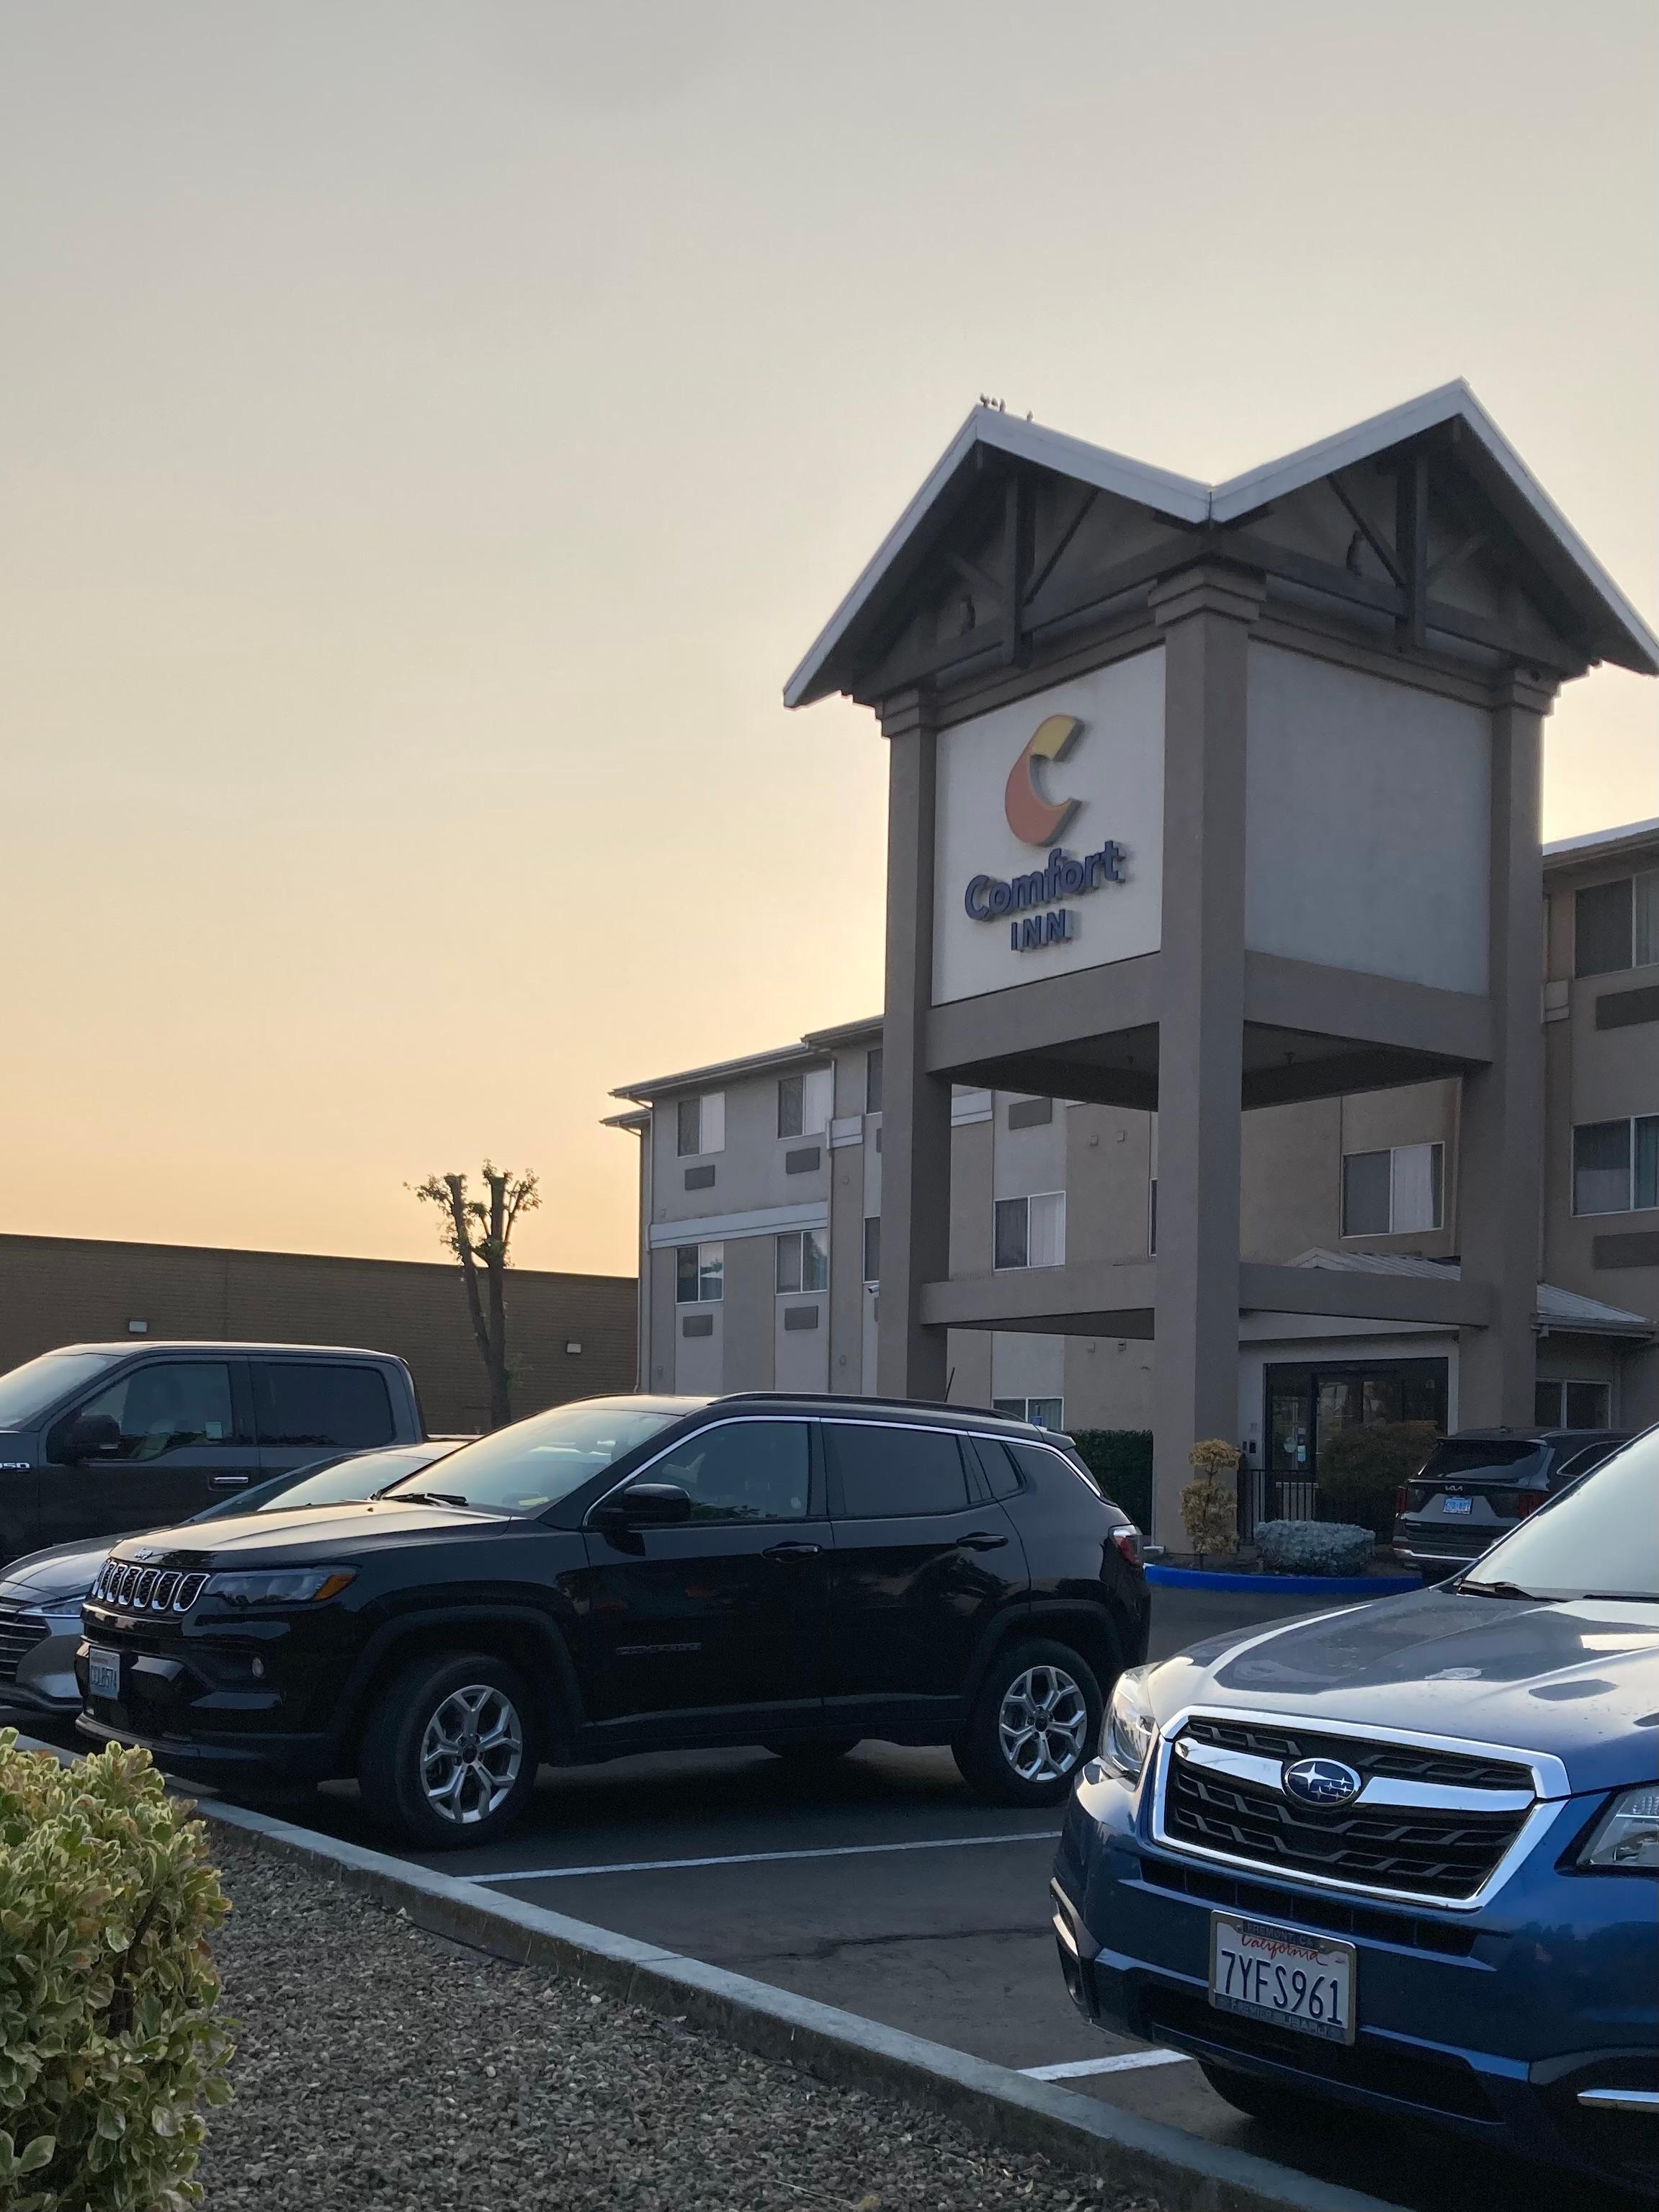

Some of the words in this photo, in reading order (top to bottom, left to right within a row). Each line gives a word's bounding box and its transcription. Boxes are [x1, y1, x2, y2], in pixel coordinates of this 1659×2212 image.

[965, 840, 1125, 921] Comfort
[1011, 909, 1071, 951] INN
[1241, 1933, 1328, 1966] California
[1221, 1948, 1343, 2026] 7YFS961
